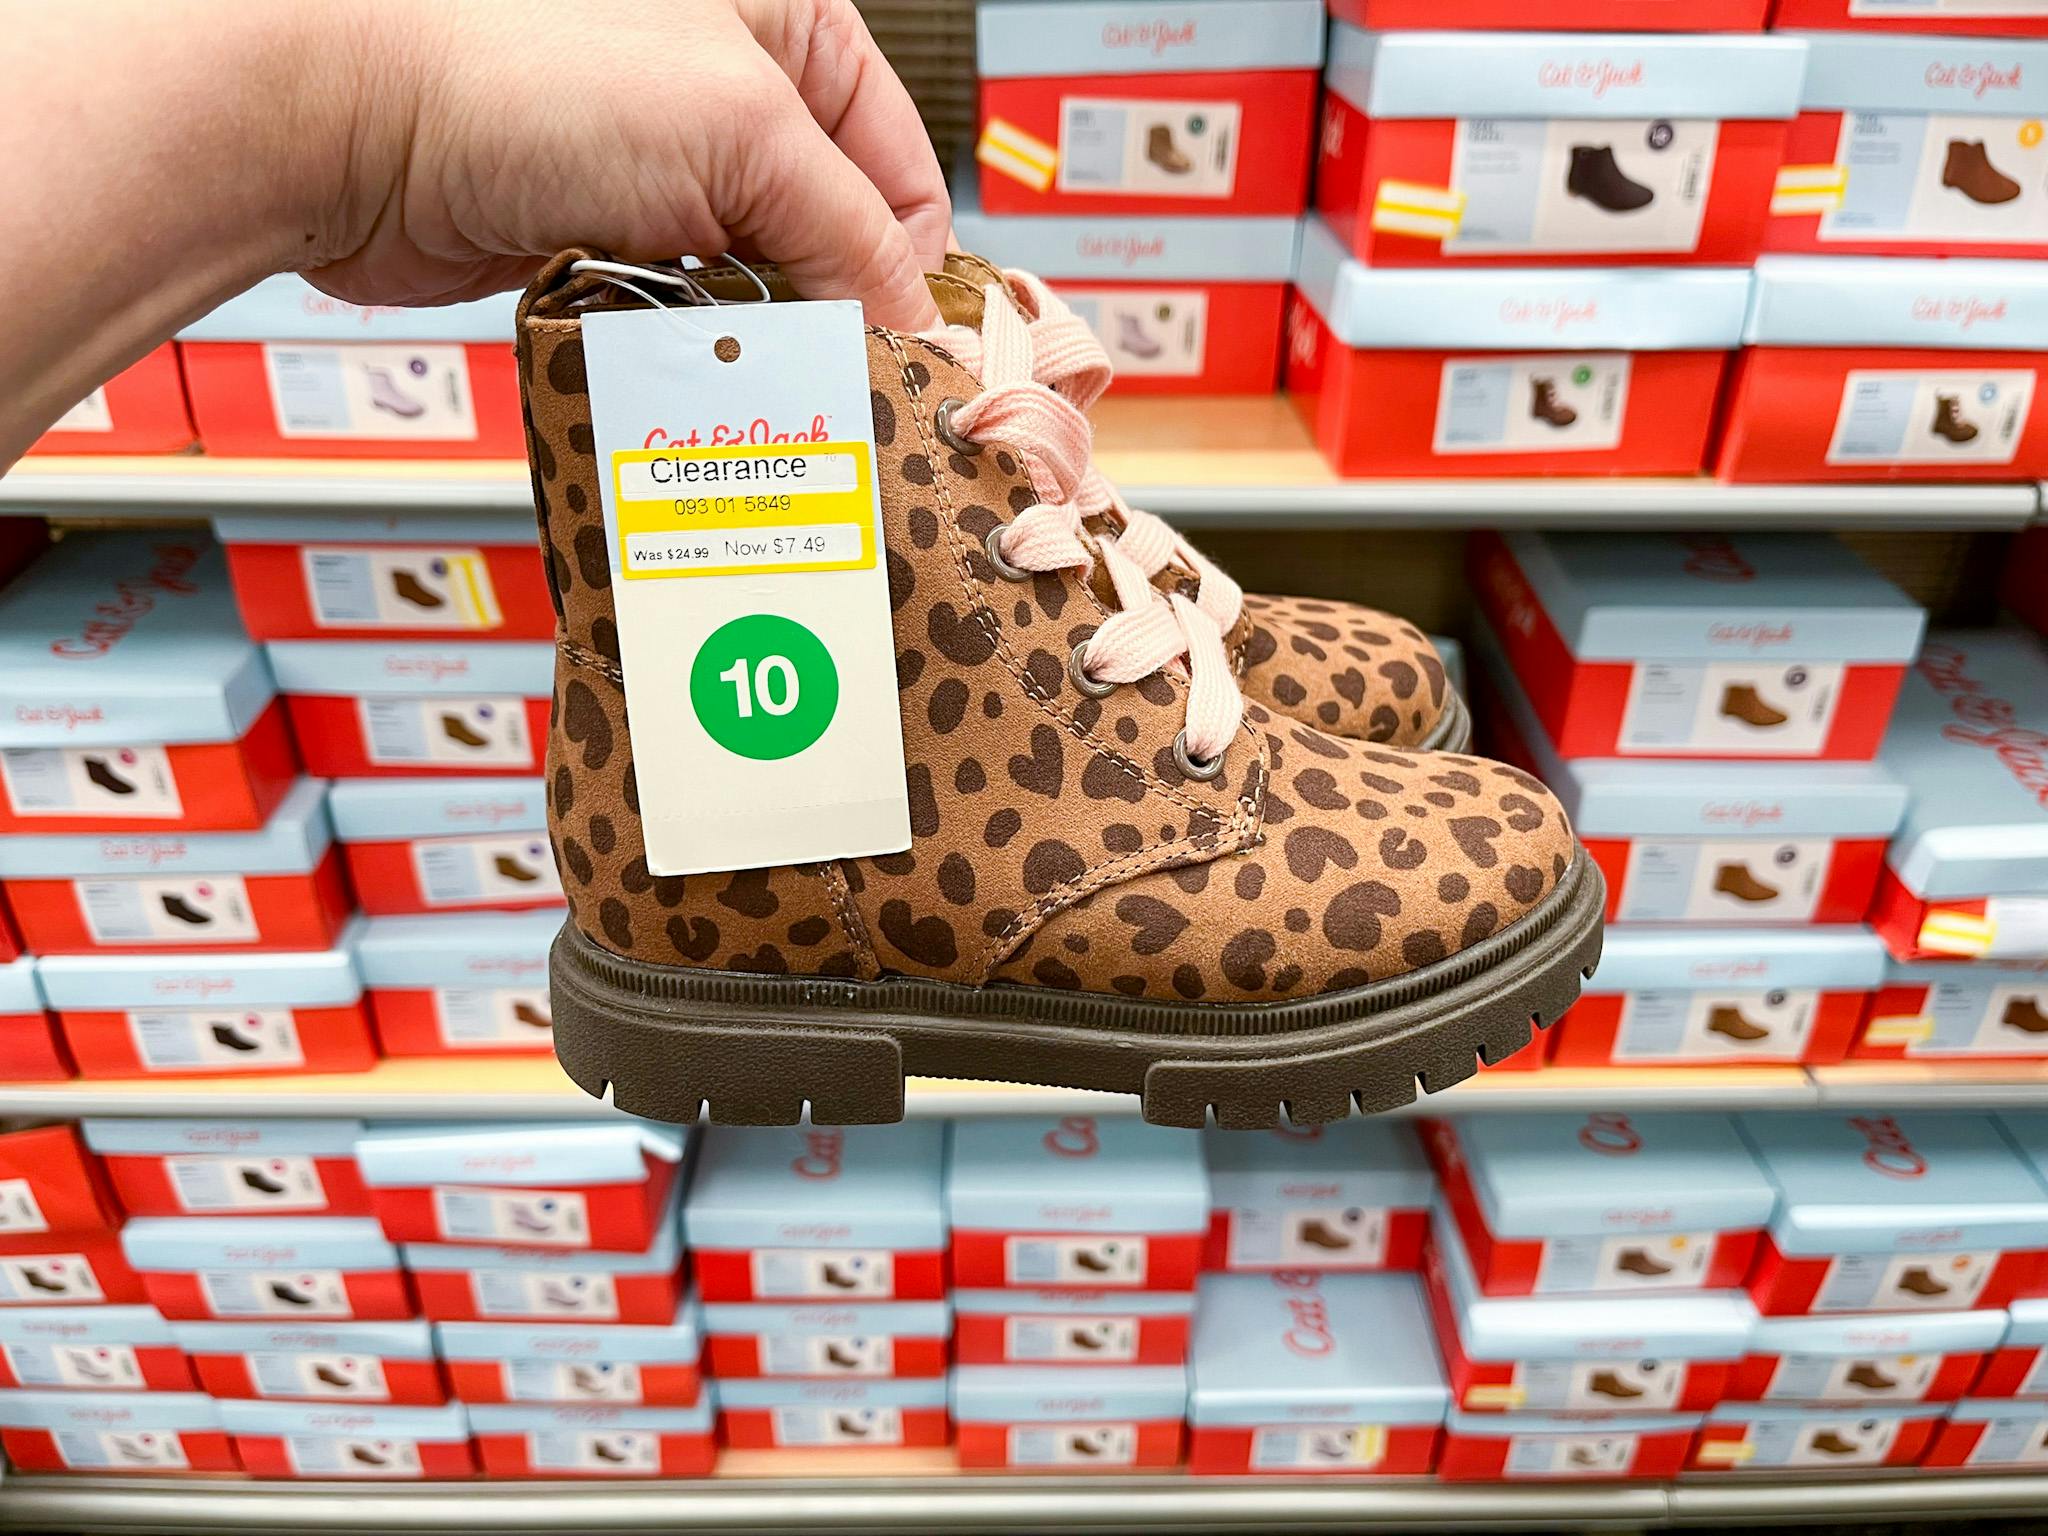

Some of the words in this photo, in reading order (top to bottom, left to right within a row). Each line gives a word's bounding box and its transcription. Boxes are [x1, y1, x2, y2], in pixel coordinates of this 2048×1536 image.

[651, 456, 806, 484] Clearance
[674, 497, 709, 515] 093
[714, 496, 736, 513] 01
[744, 494, 791, 512] 5849
[634, 550, 663, 561] Was
[667, 547, 709, 560] $24.99
[725, 540, 767, 556] Now
[773, 536, 826, 555] $7.49
[719, 654, 801, 718] 10
